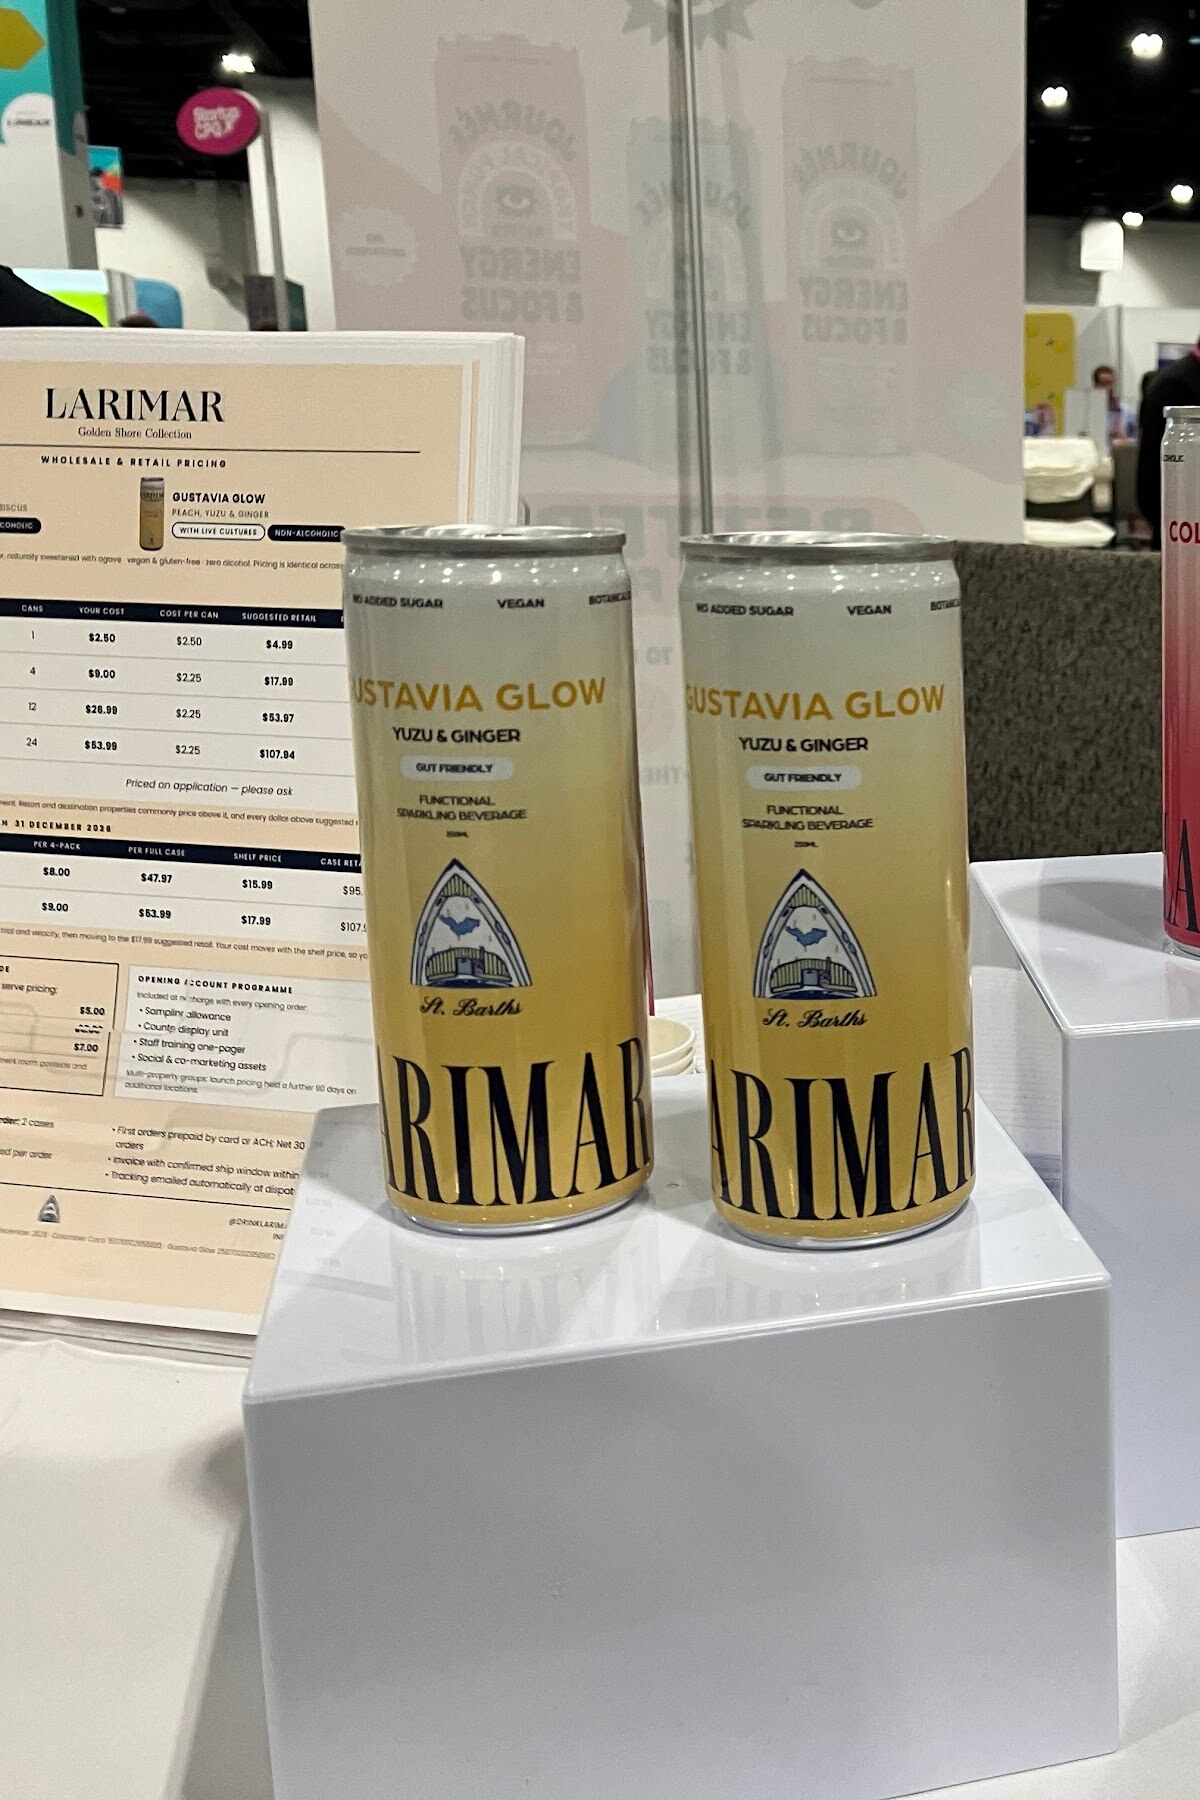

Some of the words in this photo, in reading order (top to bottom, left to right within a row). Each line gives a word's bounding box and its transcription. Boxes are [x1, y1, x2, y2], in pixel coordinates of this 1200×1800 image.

[46, 387, 225, 423] LARIMAR
[78, 427, 112, 437] Golden
[115, 427, 141, 438] Shore
[145, 428, 192, 439] Collection
[41, 455, 110, 466] WHOLESALE
[130, 458, 170, 467] RETAIL
[177, 459, 226, 468] PRICING
[172, 492, 229, 504] GUSTAVIA
[233, 493, 266, 504] GLOW
[238, 510, 269, 519] GINGER
[219, 527, 257, 536] CULTURES
[274, 529, 339, 538] NON-ALCOHOLIC
[364, 596, 397, 607] ADDED
[400, 597, 443, 609] SUGAR
[497, 598, 544, 609] VEGAN
[21, 604, 44, 613] CANS
[241, 612, 289, 622] SUGGESTED
[710, 604, 746, 616] ADDED
[749, 605, 794, 617] SUGAR
[847, 605, 892, 616] VEGAN
[88, 632, 116, 643] $2.50
[176, 636, 202, 647] $2.50
[266, 639, 293, 650] $4.99
[88, 668, 116, 680] $9.00
[176, 672, 202, 684] $2.25
[264, 675, 294, 687] $17.99
[352, 677, 484, 712] USTAVIA
[496, 677, 606, 712] GLOW
[686, 682, 834, 721] GUSTAVIA
[844, 683, 945, 720] GLOW
[176, 708, 201, 719] $2.25
[262, 712, 294, 724] $53.97
[392, 726, 433, 742] YUZU
[437, 729, 447, 742] &
[451, 728, 520, 743] GINGER
[739, 736, 782, 751] YUZU
[786, 738, 797, 751] &
[800, 737, 868, 751] GINGER
[175, 744, 201, 755] $2.25
[259, 749, 295, 761] $107.94
[416, 762, 437, 773] GUT
[439, 763, 493, 774] FRIENDLY
[764, 772, 786, 783] GUT
[788, 772, 842, 783] FRIENDLY
[126, 777, 156, 789] Priced
[173, 780, 228, 796] application
[240, 783, 274, 797] please
[277, 786, 293, 797] ask
[419, 795, 495, 806] FUNCTIONAL
[458, 808, 527, 821] BEVERAGE
[767, 805, 844, 816] FUNCTIONAL
[29, 820, 82, 831] DECEMBER
[742, 818, 805, 831] SPARKLING
[807, 818, 874, 831] BEVERAGE
[43, 866, 71, 878] $8.00
[140, 872, 173, 884] $47.97
[242, 878, 273, 891] $15.99
[41, 901, 69, 913] $9.00
[241, 915, 271, 927] $17.99
[138, 975, 181, 985] OPENING
[231, 983, 293, 994] PROGRAMME
[80, 1006, 105, 1016] $5.00
[419, 995, 445, 1016] St.
[452, 997, 523, 1017] Barths
[187, 1010, 231, 1022] allowance
[762, 1008, 790, 1028] St.
[800, 1009, 868, 1029] Barths
[178, 1024, 210, 1036] display
[74, 1043, 99, 1053] $7.00
[162, 1039, 195, 1051] training
[198, 1043, 245, 1055] one-pager
[137, 1053, 164, 1063] Social
[174, 1057, 236, 1070] co-marketing
[238, 1062, 267, 1071] assets
[167, 1131, 203, 1143] prepaid
[167, 1160, 213, 1172] confirmed
[189, 1178, 251, 1194] automatically
